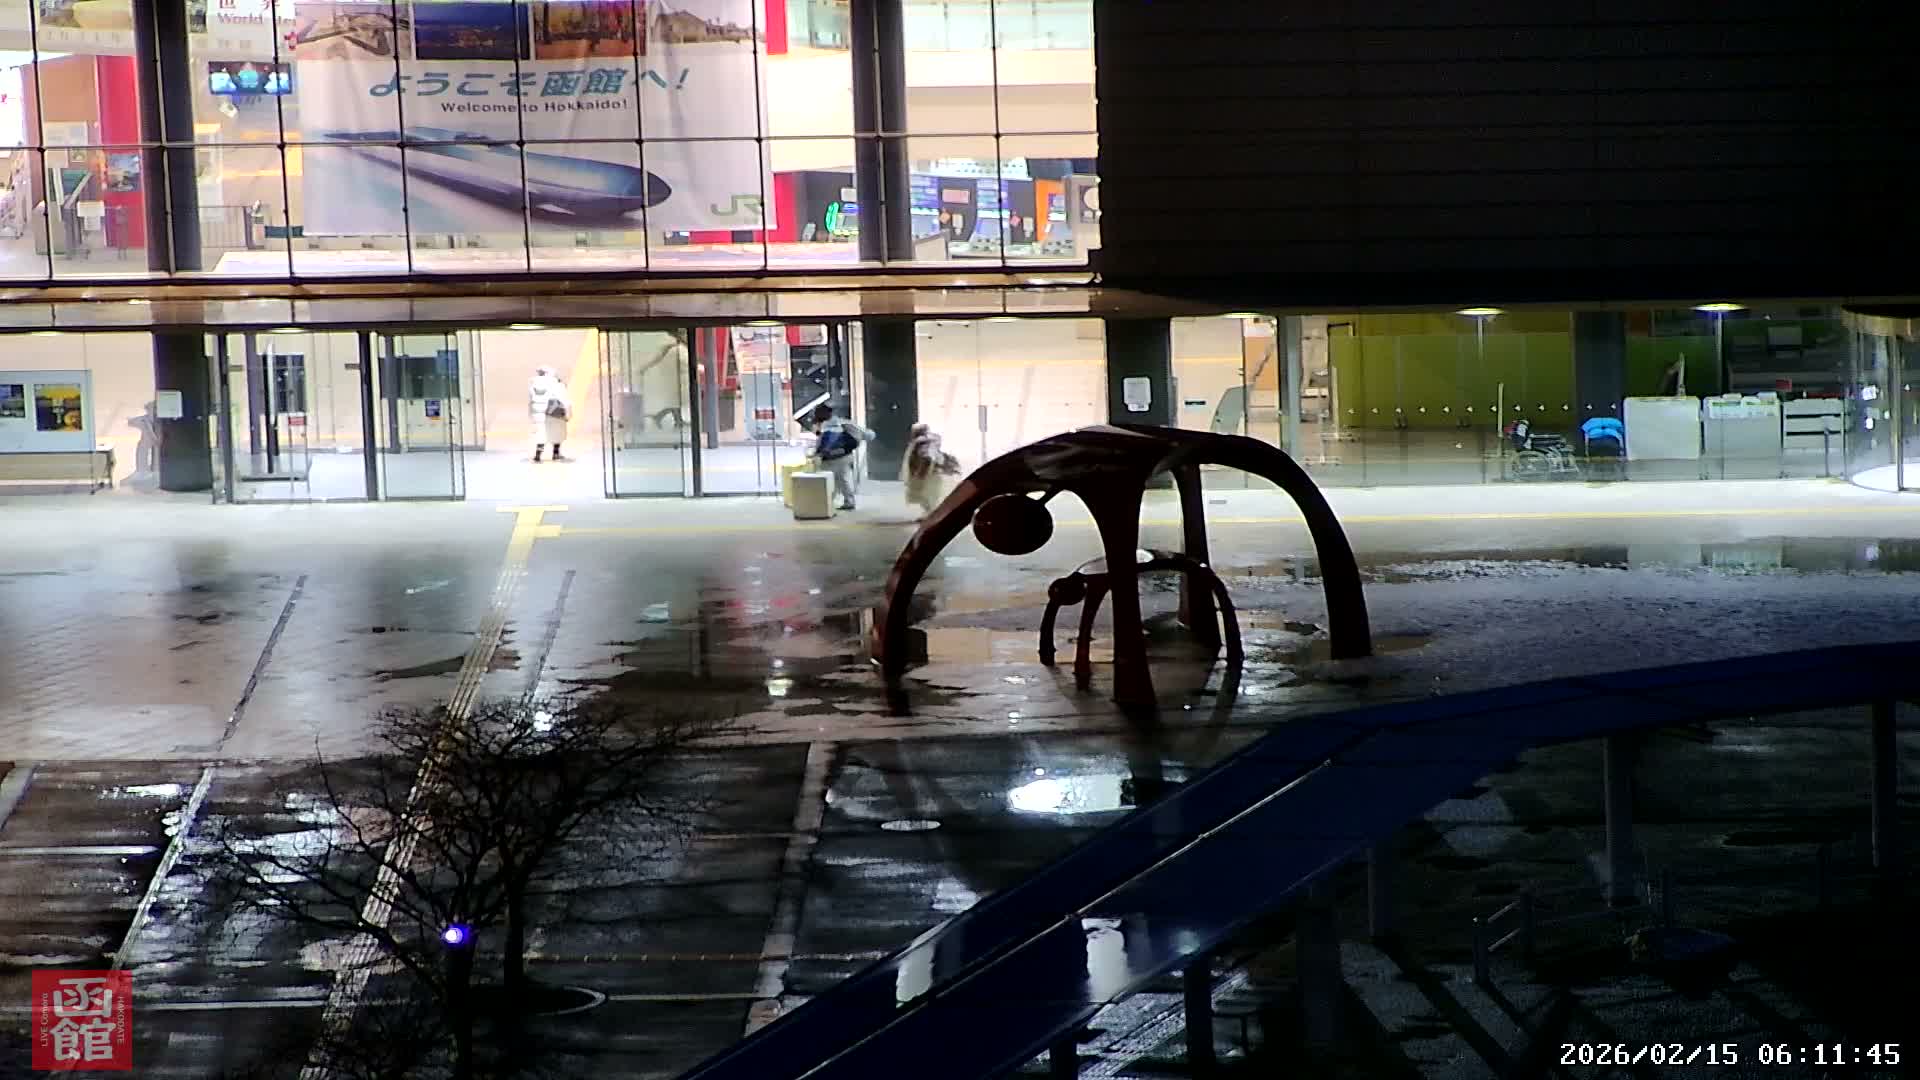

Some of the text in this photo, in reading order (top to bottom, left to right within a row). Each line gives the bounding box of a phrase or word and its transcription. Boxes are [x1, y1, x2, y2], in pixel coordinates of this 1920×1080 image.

[441, 99, 628, 113] Welcome to Hokkaido!
[711, 193, 764, 217] JR
